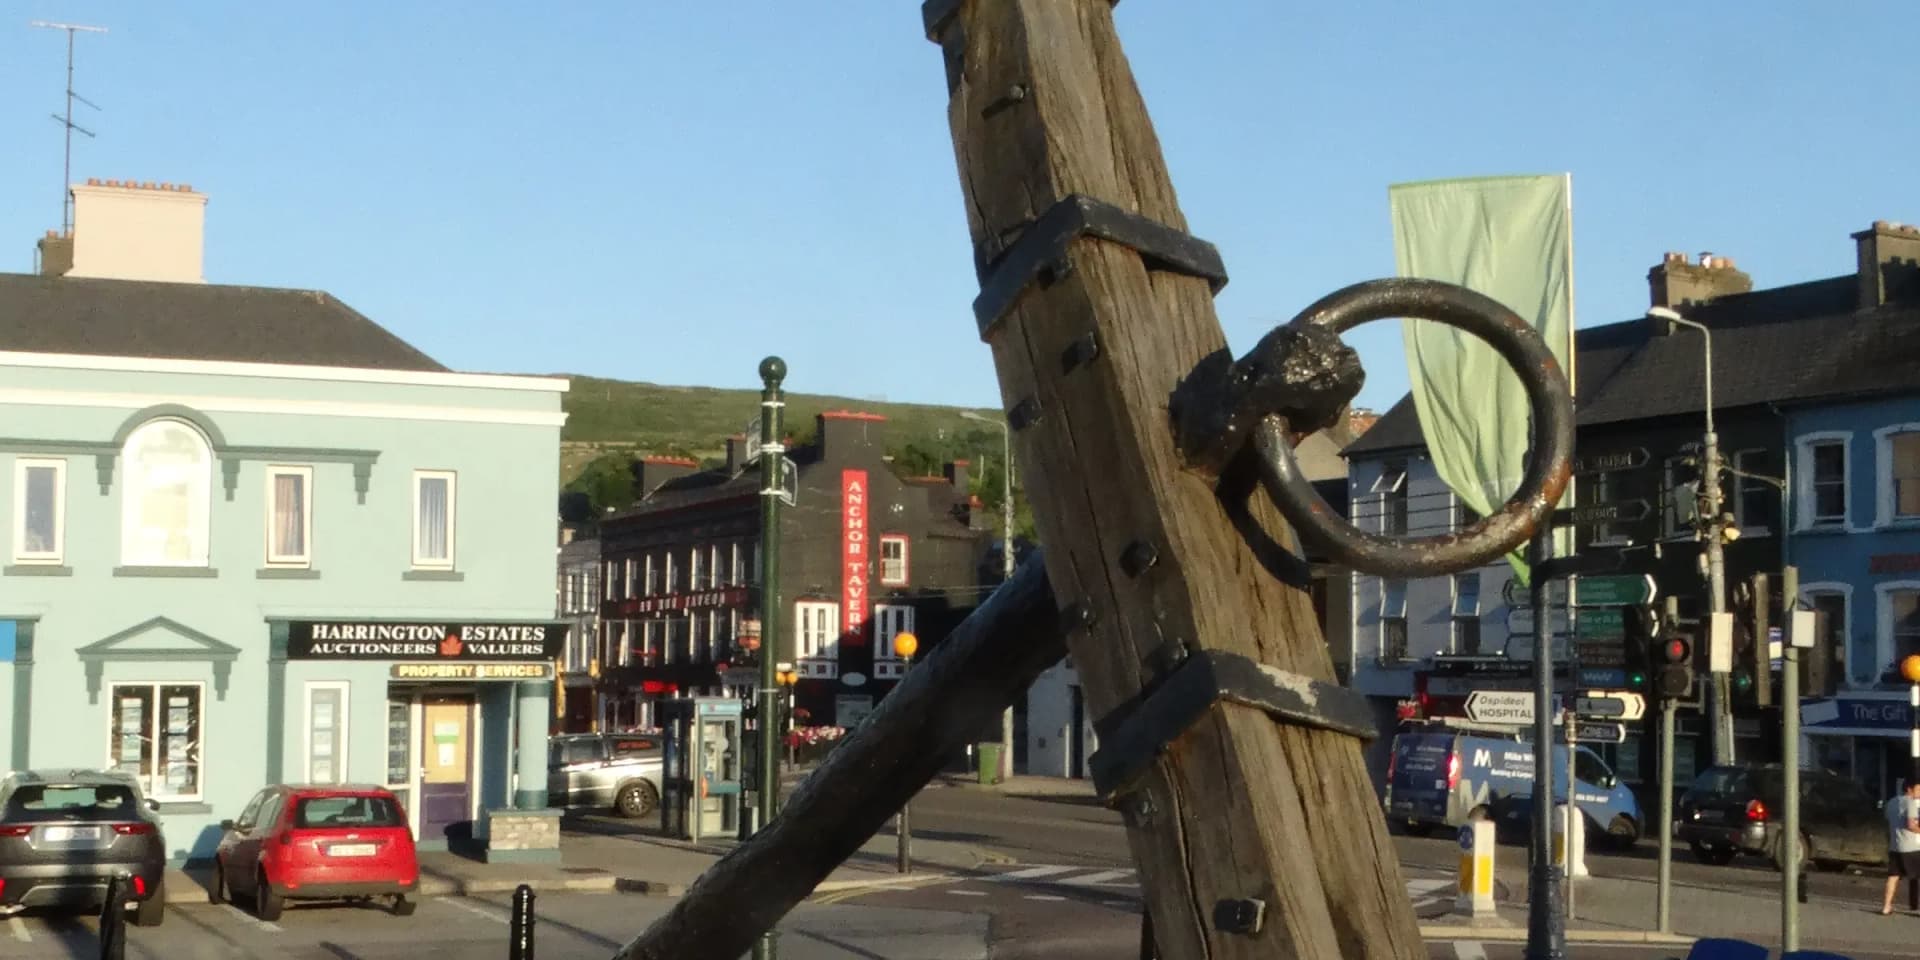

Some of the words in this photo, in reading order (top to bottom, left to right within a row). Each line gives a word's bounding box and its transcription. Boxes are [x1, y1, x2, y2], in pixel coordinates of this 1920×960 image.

[848, 480, 863, 554] ANCHOR
[848, 562, 863, 635] TAVERN
[311, 624, 447, 640] HARRINGTON
[461, 626, 546, 641] ESTATES
[310, 643, 437, 654] AUCTIONEERS
[468, 644, 544, 655] VALUERS
[399, 664, 474, 677] PROPERTY
[476, 665, 544, 677] SERVICES
[1479, 708, 1533, 719] HOSPITAL
[1850, 703, 1879, 721] The
[1882, 703, 1908, 721] Gift
[1473, 748, 1492, 768] M
